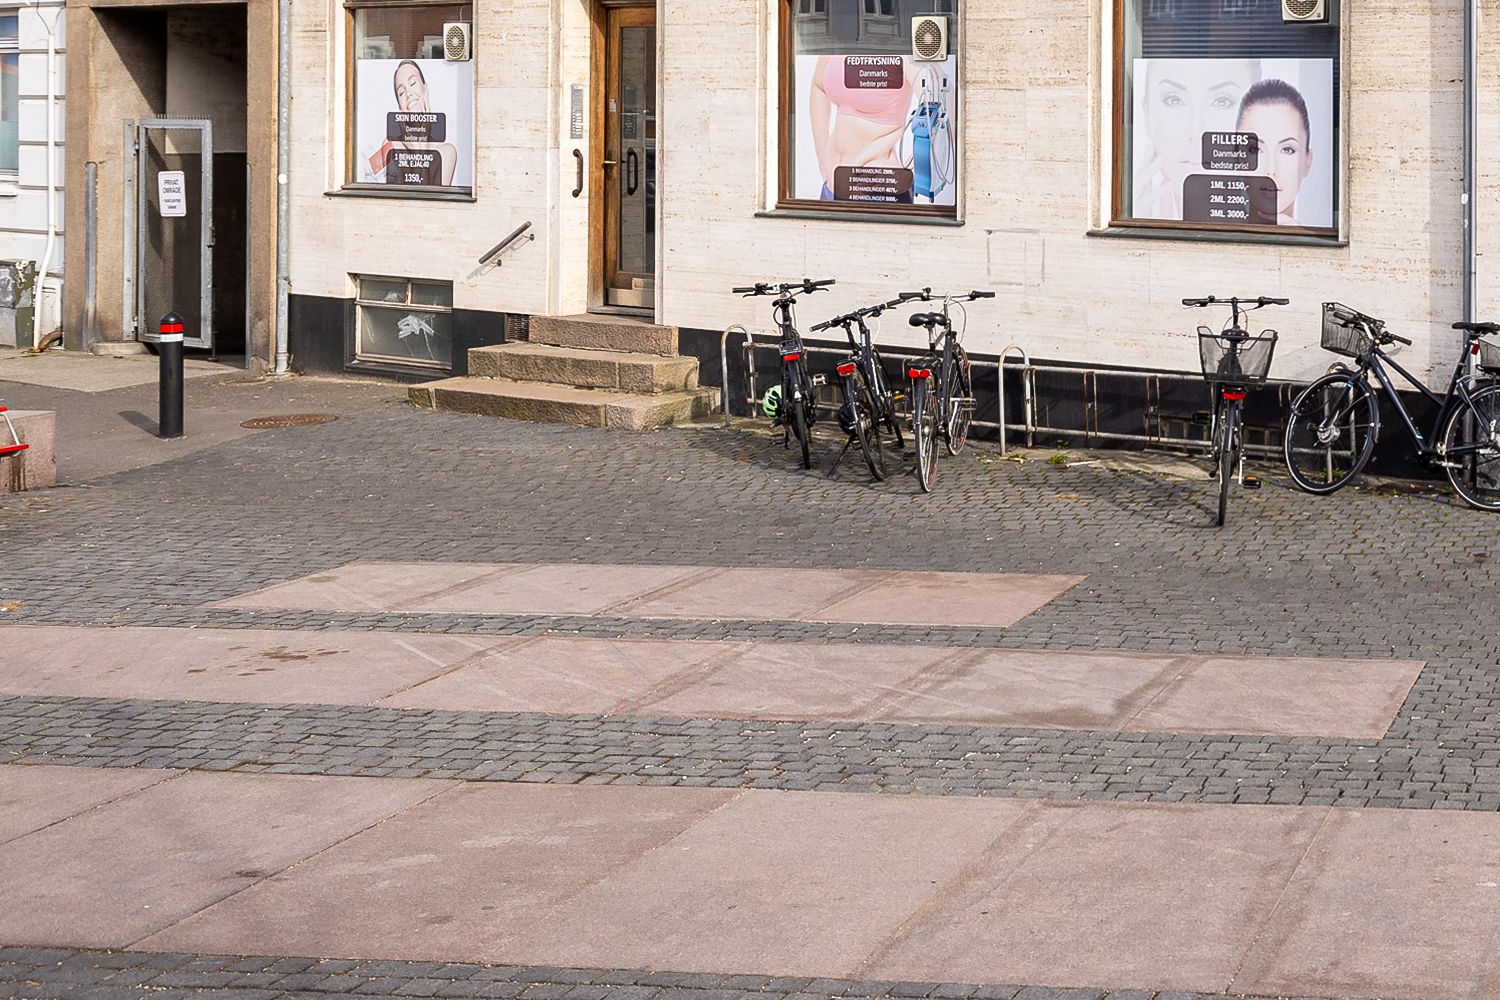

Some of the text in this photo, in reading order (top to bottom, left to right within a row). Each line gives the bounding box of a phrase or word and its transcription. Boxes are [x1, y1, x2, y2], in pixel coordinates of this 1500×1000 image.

[847, 56, 900, 65] FEDTFRYSNING
[859, 70, 888, 78] Danmarks
[395, 114, 437, 122] SKIN BOOSTER
[1212, 134, 1249, 145] FILLERS
[1213, 149, 1247, 158] Danmarks
[1210, 161, 1249, 171] bedste pris!
[405, 174, 423, 183] 1350,-
[1210, 181, 1249, 190] 1ML 1150,-
[1210, 195, 1249, 205] 2ML 2200,-
[1210, 209, 1249, 219] 3ML 3000,-
